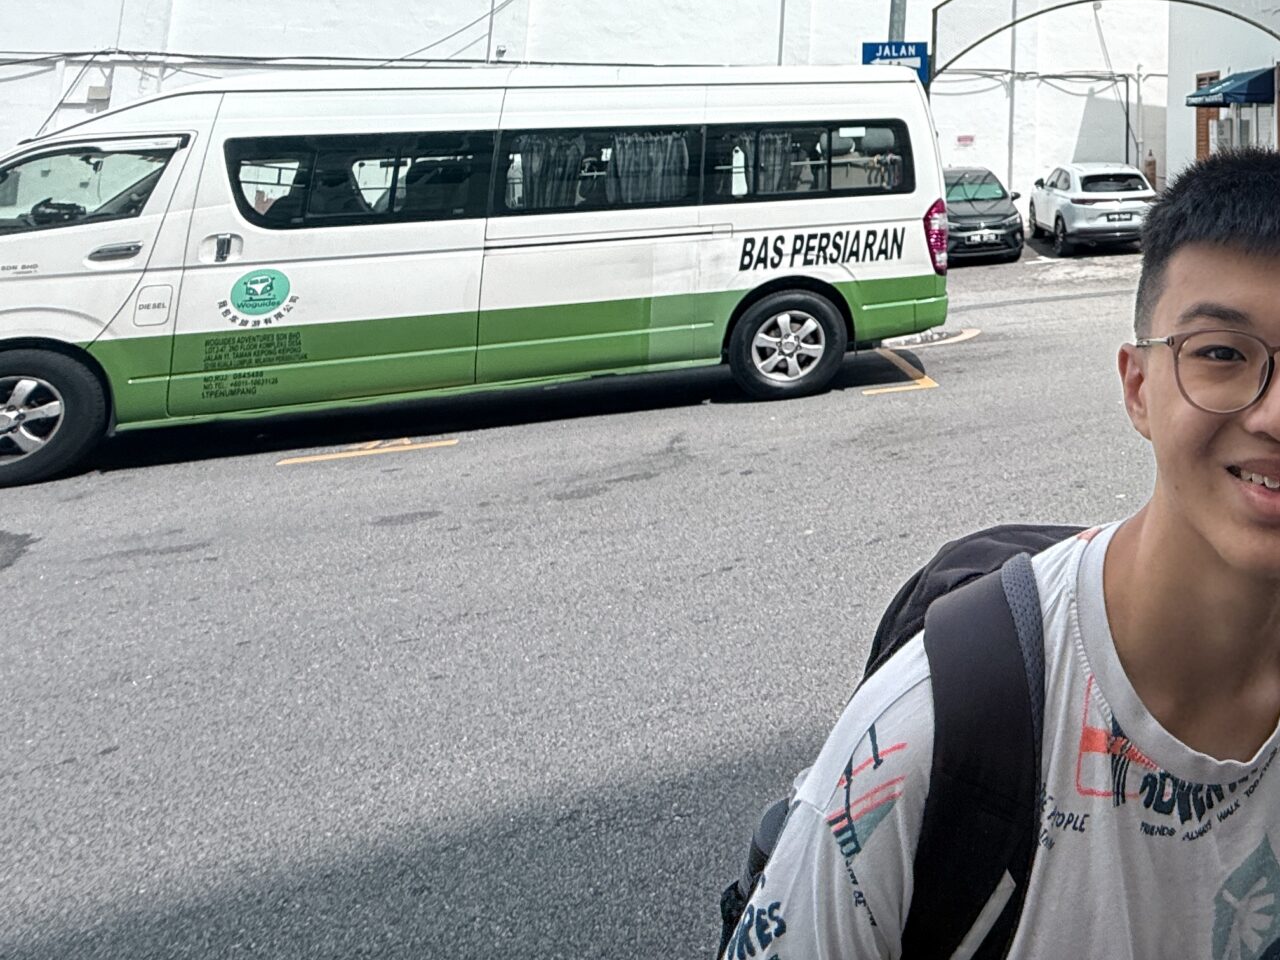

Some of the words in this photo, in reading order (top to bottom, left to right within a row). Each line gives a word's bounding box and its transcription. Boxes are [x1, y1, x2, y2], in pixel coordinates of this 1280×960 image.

[875, 44, 916, 57] JALAN
[738, 235, 785, 272] BAS
[789, 227, 906, 268] PERSIARAN
[138, 302, 167, 311] DIESEL
[236, 299, 281, 310] Woguides
[1216, 799, 1241, 823] WALK
